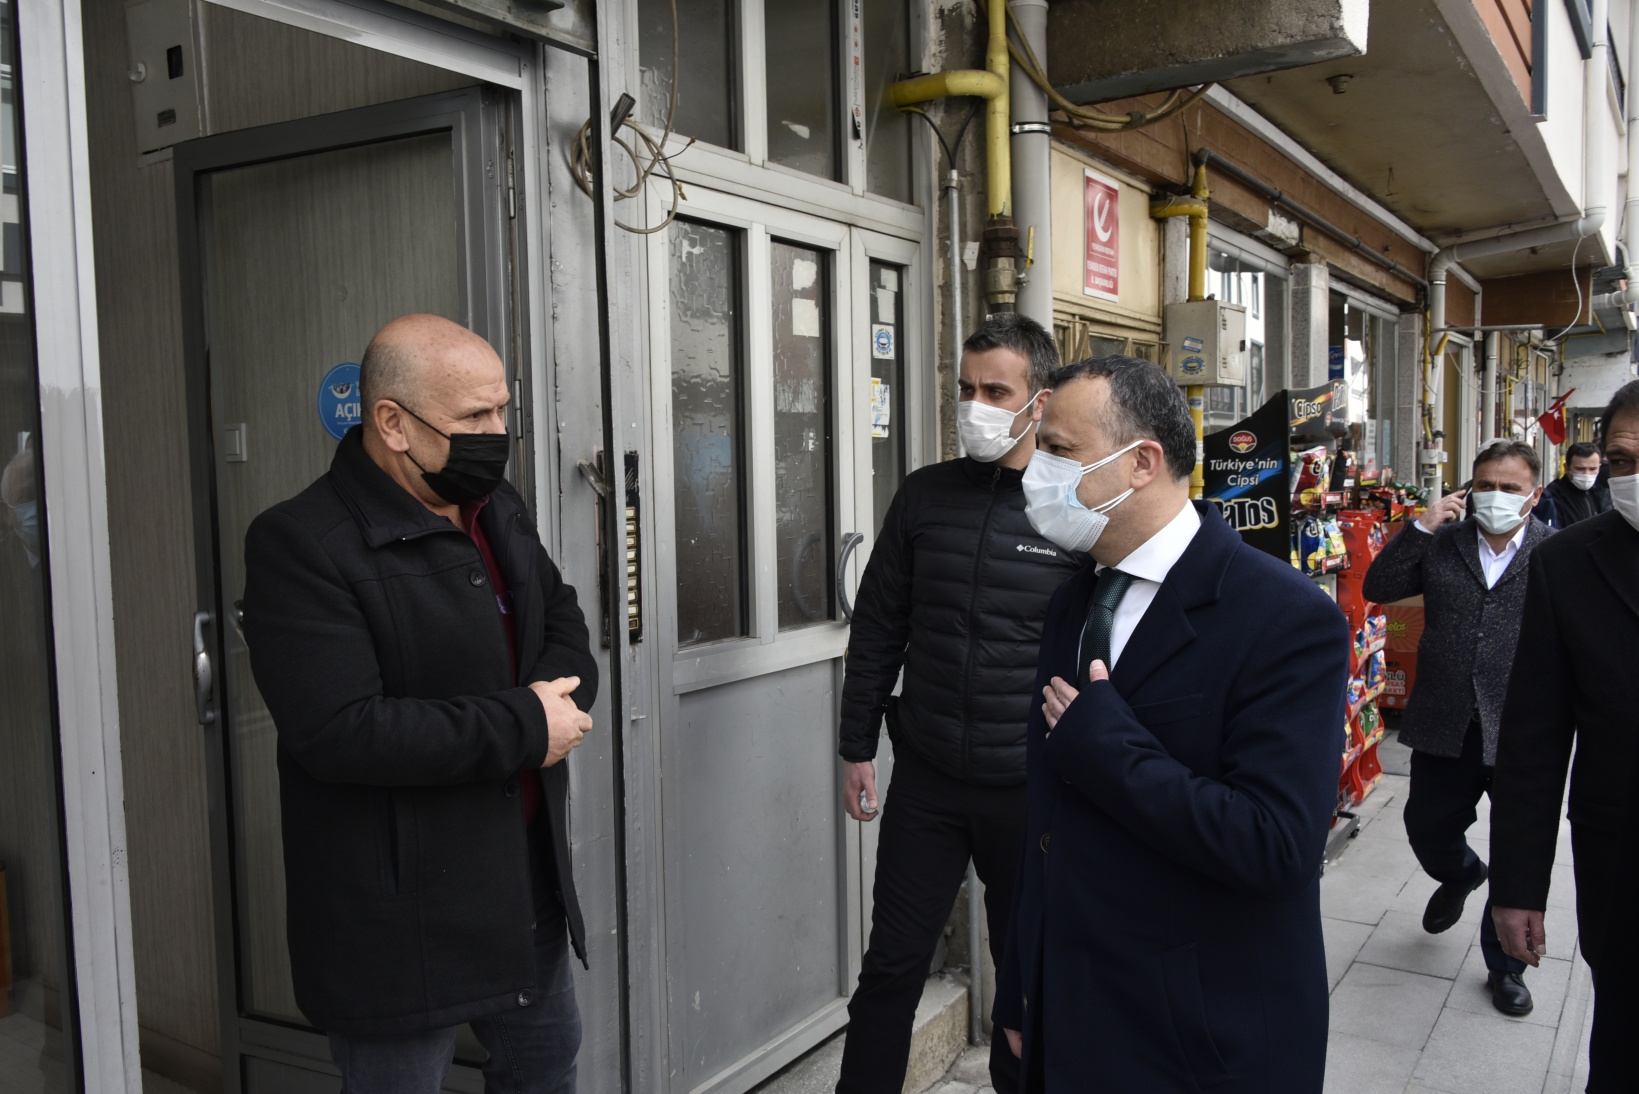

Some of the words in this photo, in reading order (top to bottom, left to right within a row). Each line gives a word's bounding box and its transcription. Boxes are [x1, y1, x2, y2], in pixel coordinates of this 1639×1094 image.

[335, 402, 361, 421] AÇI
[1295, 399, 1321, 421] Cipso
[1210, 458, 1278, 472] Türkiye'nin
[1227, 475, 1259, 488] Cipsi
[1024, 545, 1056, 557] Columbia
